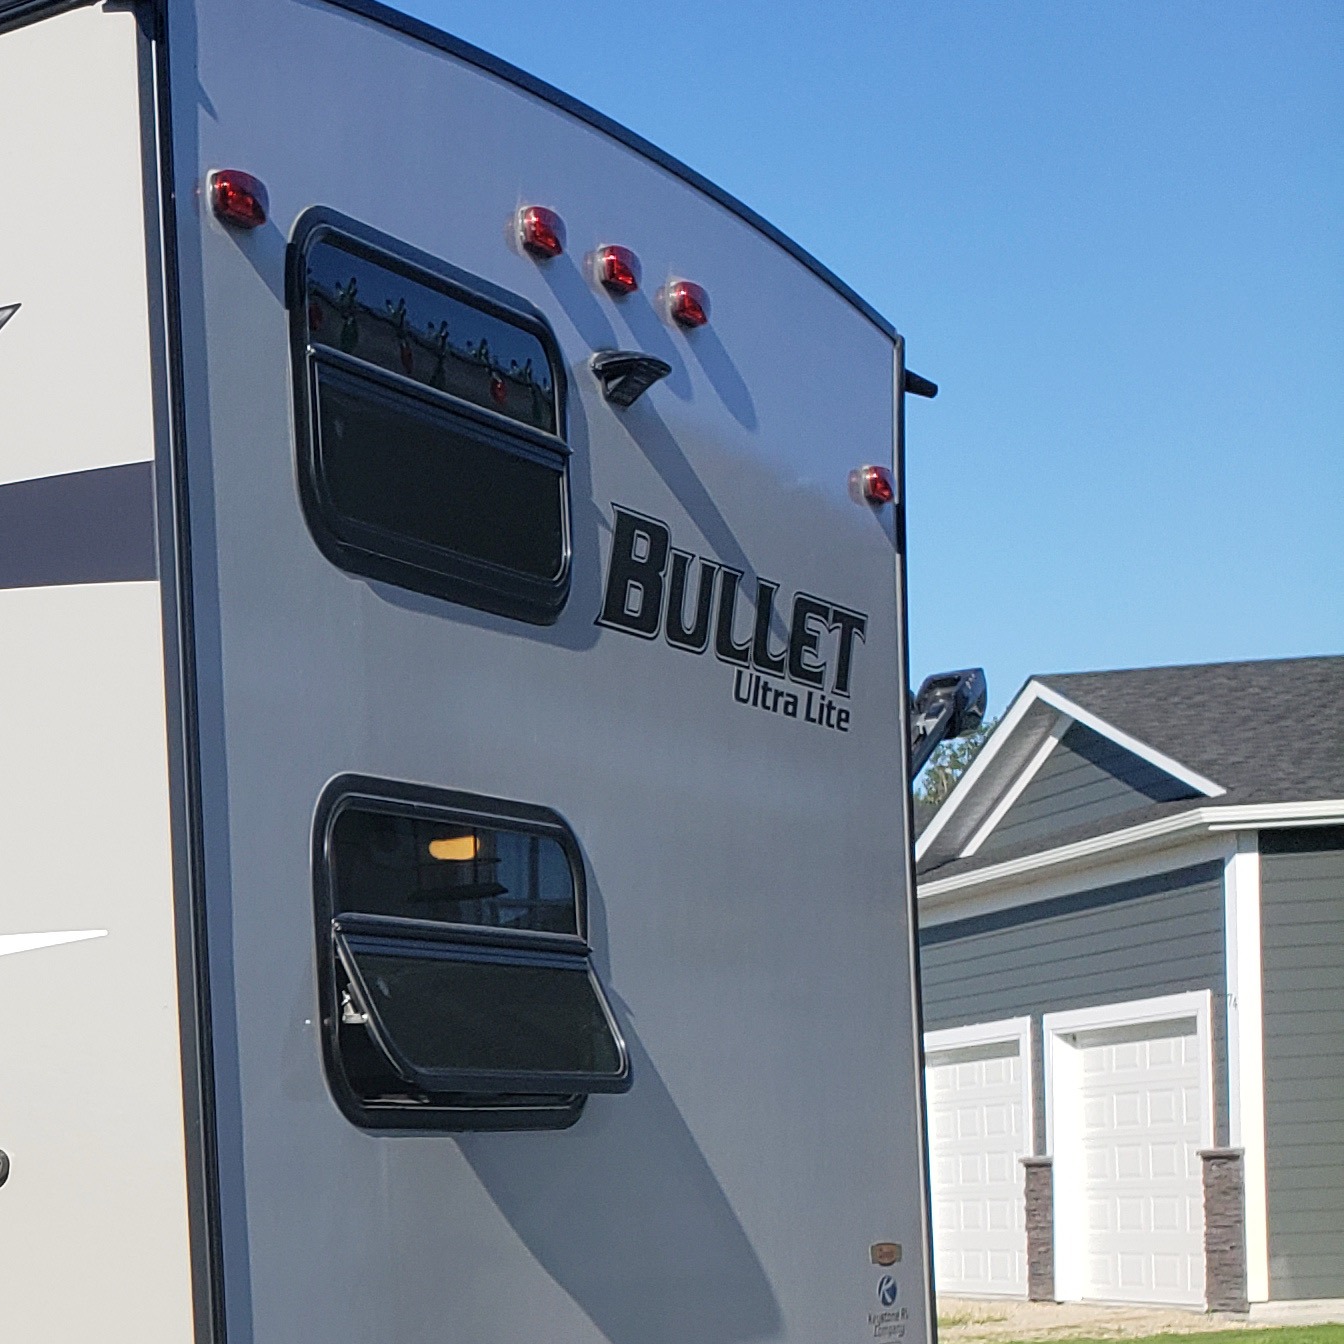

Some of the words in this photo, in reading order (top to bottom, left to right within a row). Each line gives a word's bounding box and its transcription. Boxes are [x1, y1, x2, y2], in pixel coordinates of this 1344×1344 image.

[594, 502, 868, 698] BULLET
[734, 669, 798, 719] Ultra
[804, 692, 850, 732] Lite
